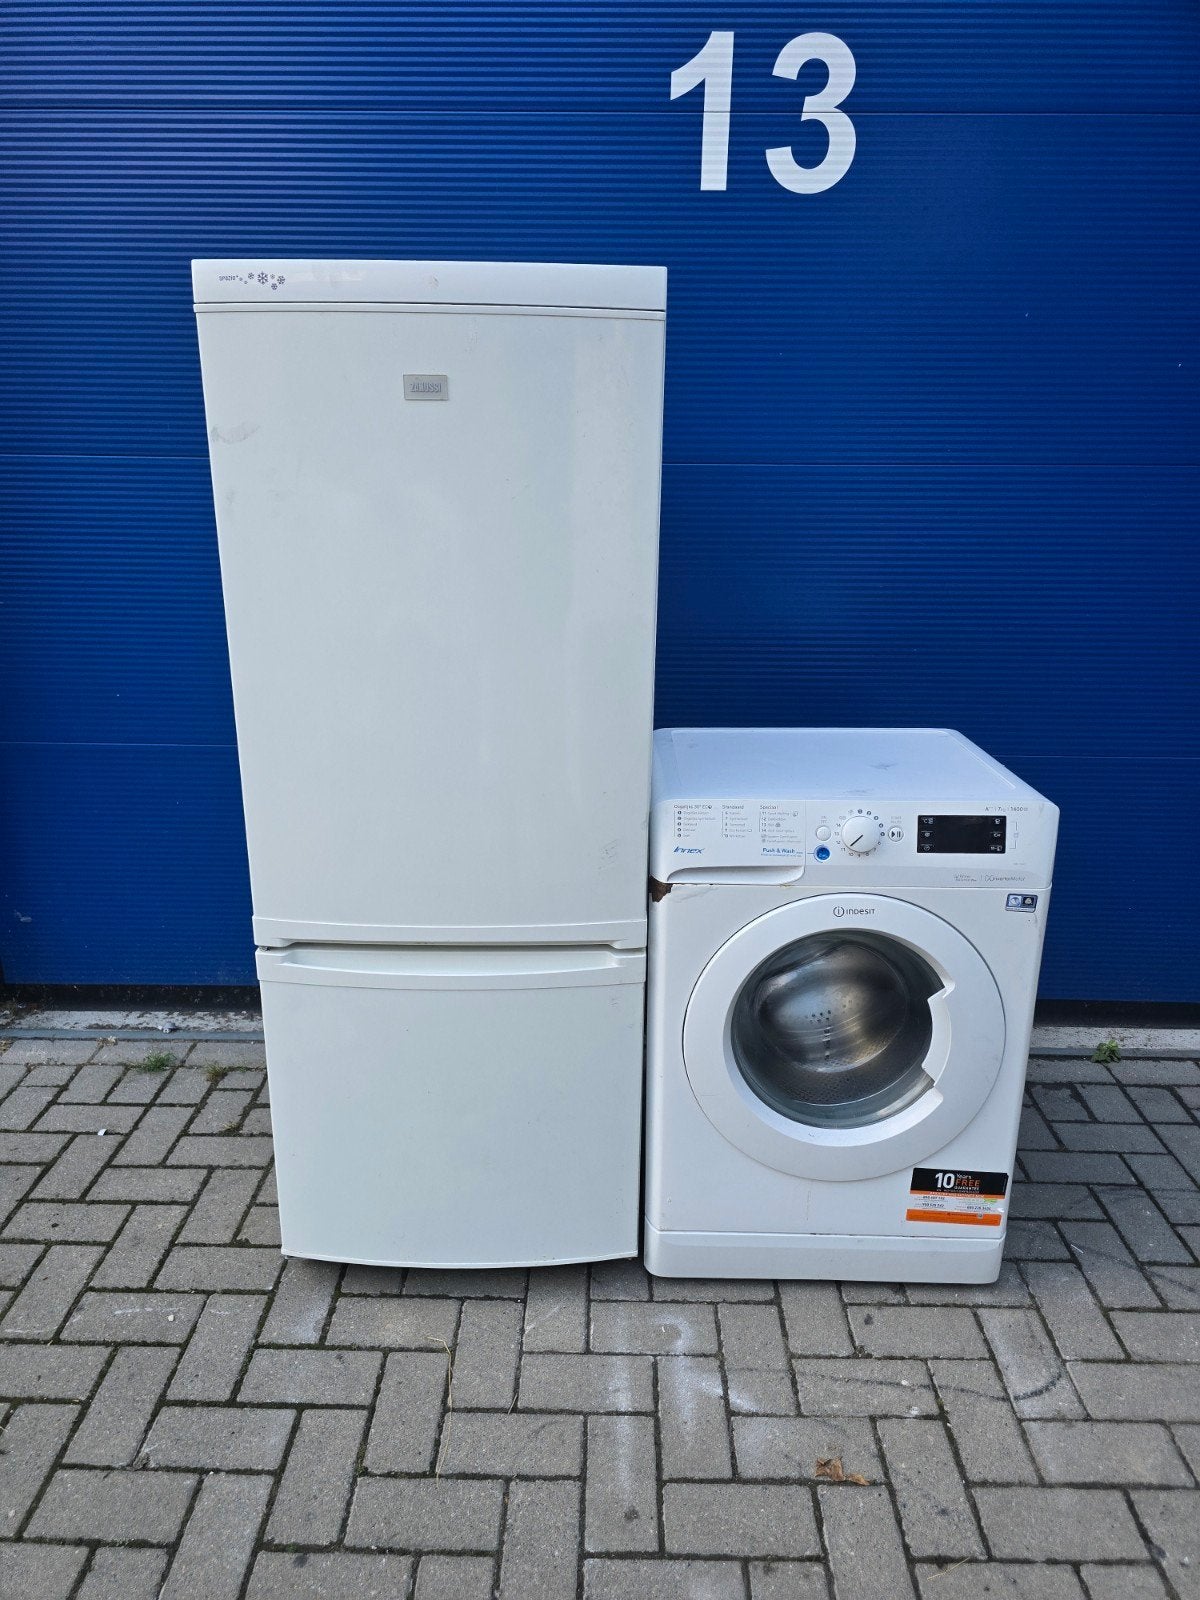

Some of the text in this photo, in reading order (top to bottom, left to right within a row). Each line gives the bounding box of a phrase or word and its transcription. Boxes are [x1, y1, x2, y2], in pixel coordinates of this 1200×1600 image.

[670, 31, 857, 194] 13
[935, 1172, 955, 1188] 10
[955, 1179, 980, 1187] FREE
